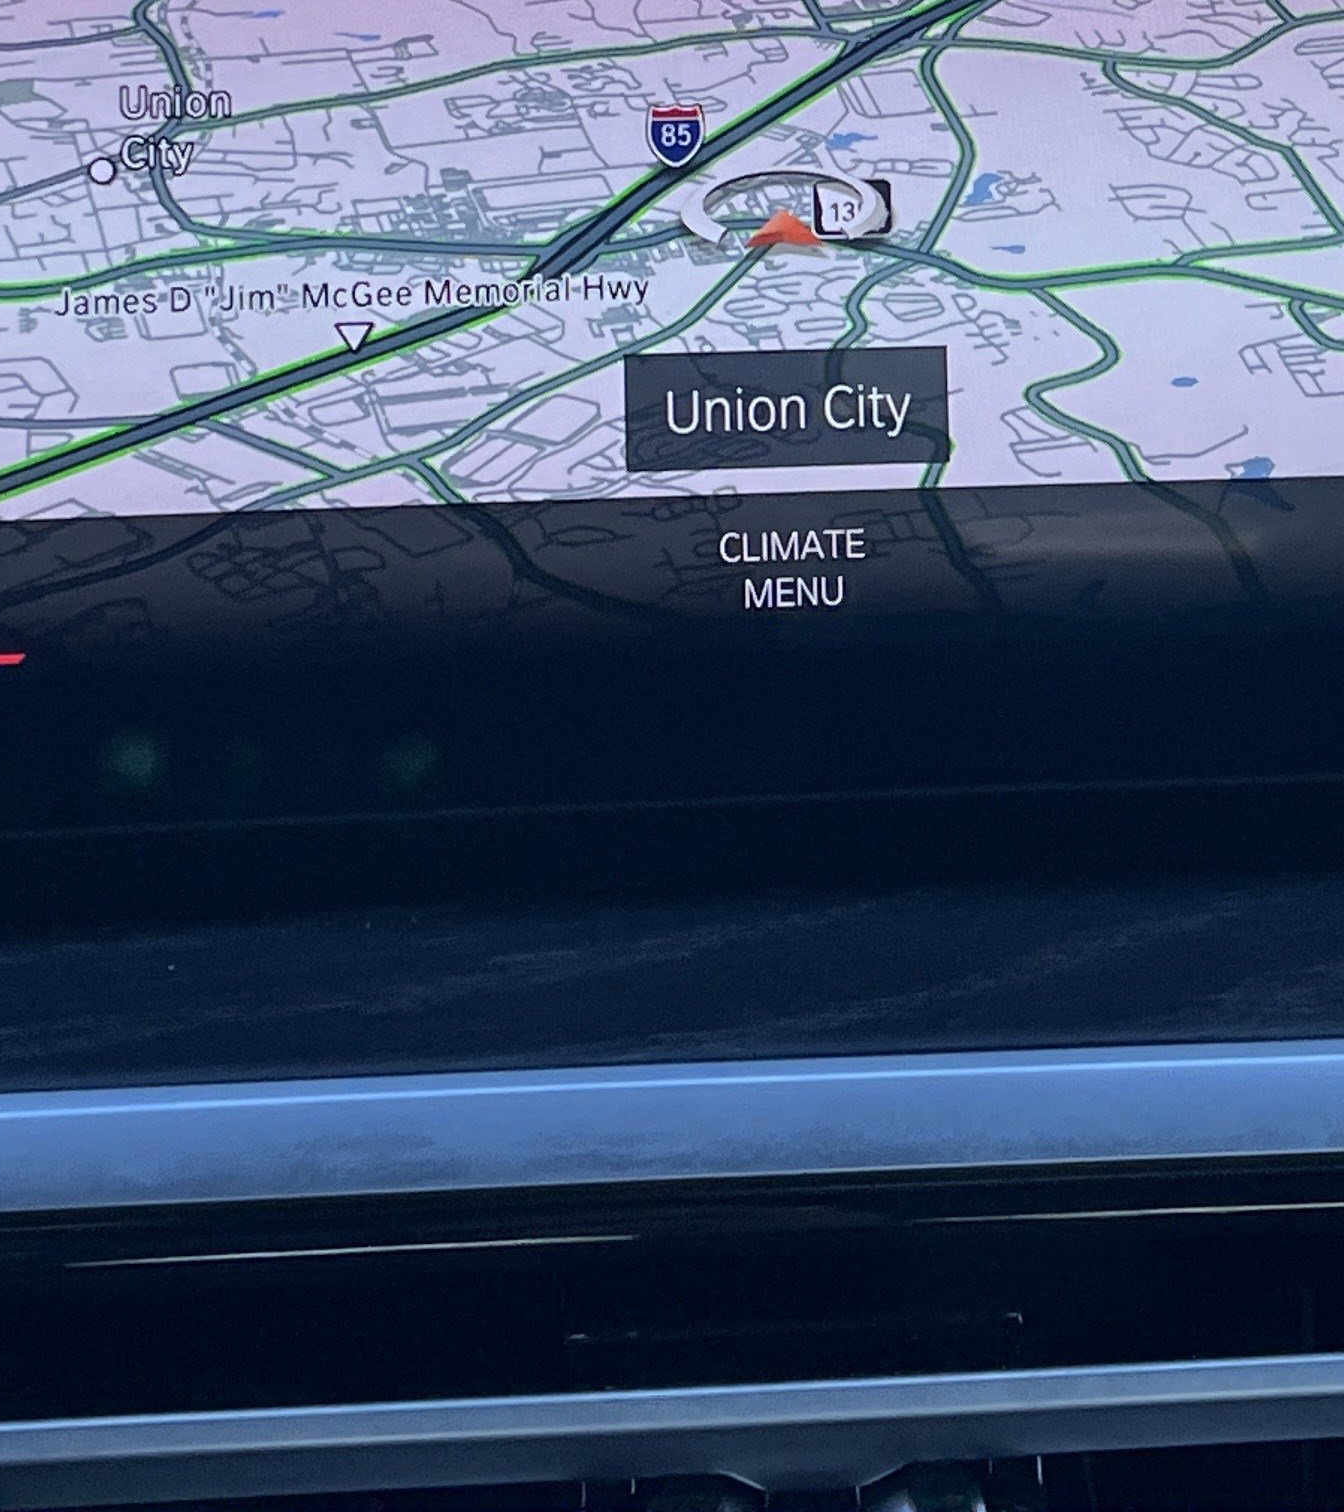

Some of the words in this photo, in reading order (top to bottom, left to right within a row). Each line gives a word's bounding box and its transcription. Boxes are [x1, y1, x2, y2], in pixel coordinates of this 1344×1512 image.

[118, 87, 232, 120] Union
[661, 123, 691, 147] 85
[120, 136, 193, 176] City
[55, 286, 157, 317] James
[169, 286, 191, 311] D
[204, 285, 288, 312] "Jim"
[301, 282, 412, 308] McGee
[425, 277, 571, 306] Memorial
[582, 277, 650, 308] Hwy
[667, 388, 805, 433] Union
[825, 384, 910, 436] City
[720, 529, 865, 562] CLIMATE
[745, 576, 843, 608] MENU
